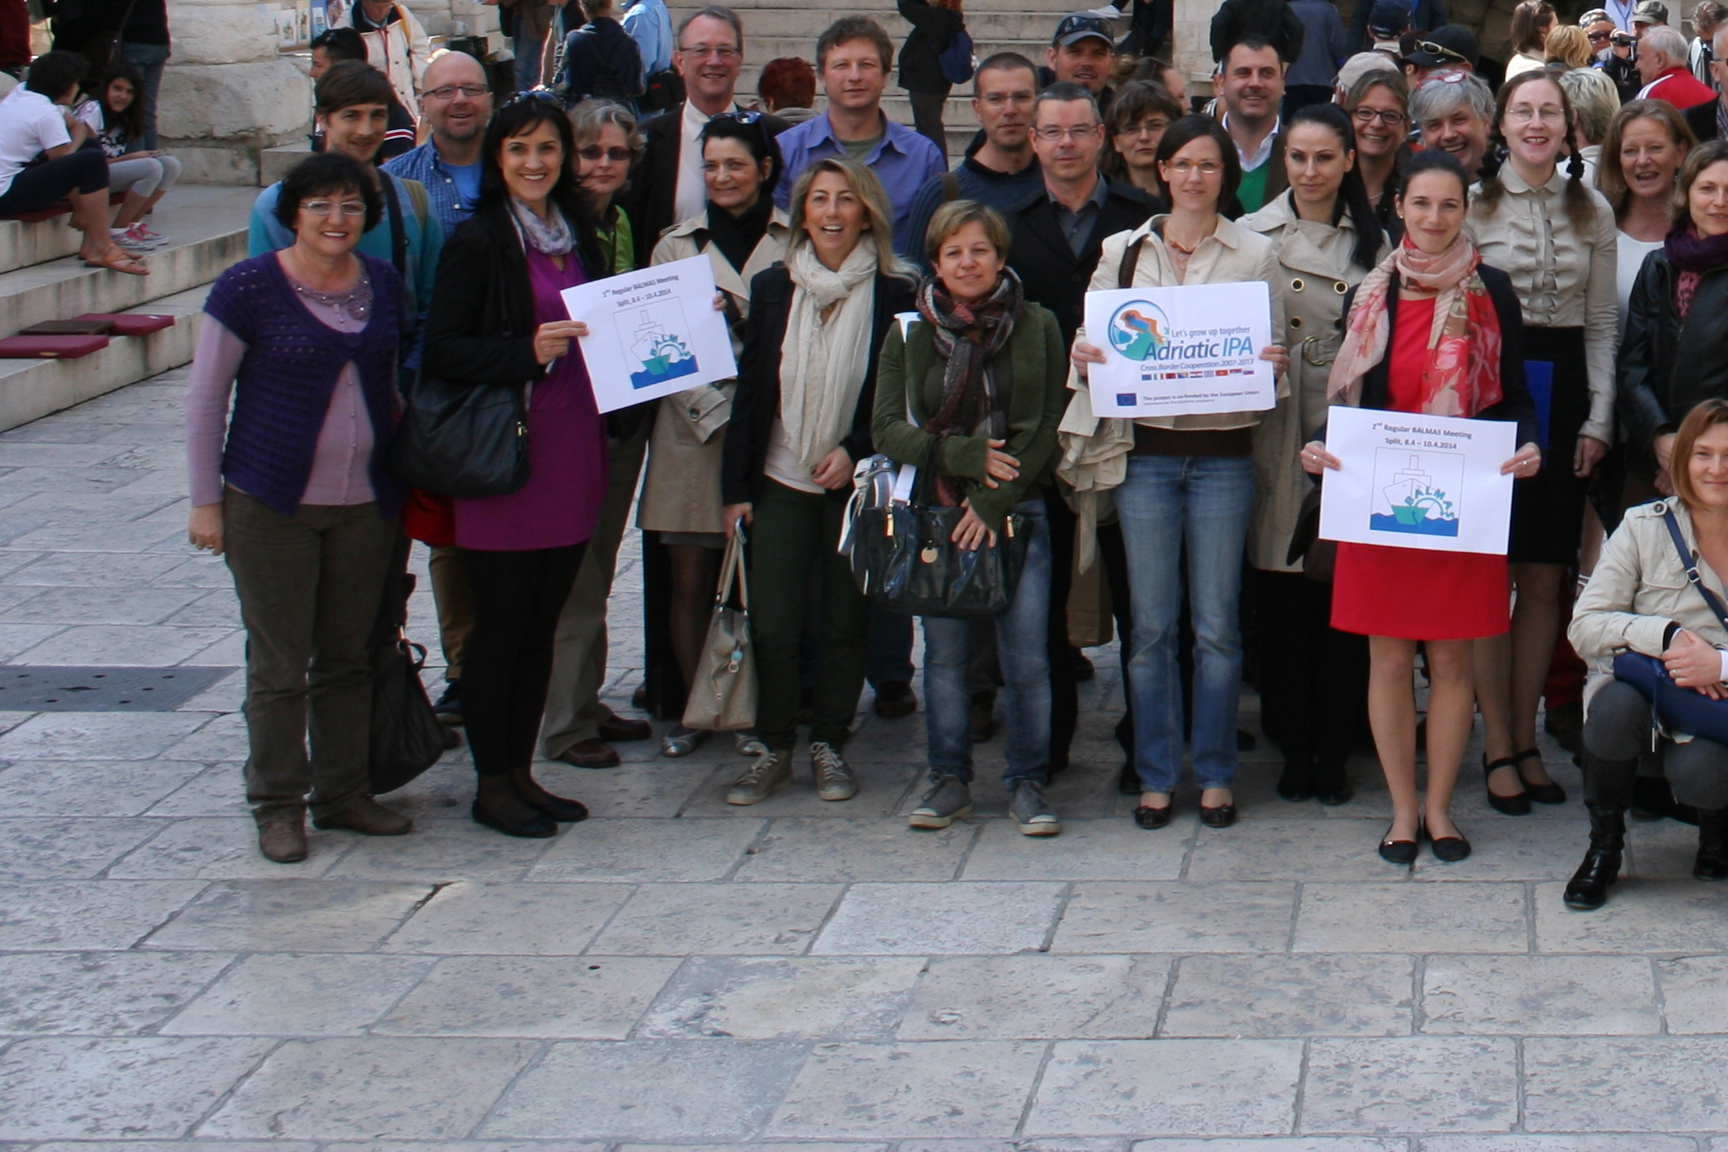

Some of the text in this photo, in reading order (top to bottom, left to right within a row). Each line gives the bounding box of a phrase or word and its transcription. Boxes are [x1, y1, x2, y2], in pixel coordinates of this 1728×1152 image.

[1189, 330, 1206, 338] grow
[1208, 330, 1218, 338] up
[1219, 327, 1250, 337] together
[1142, 336, 1254, 361] Adriatic IPA
[1384, 424, 1410, 433] Regular
[1411, 426, 1441, 436] BALMAS
[1442, 429, 1472, 440] Meeting
[1404, 486, 1454, 518] BALMAS
